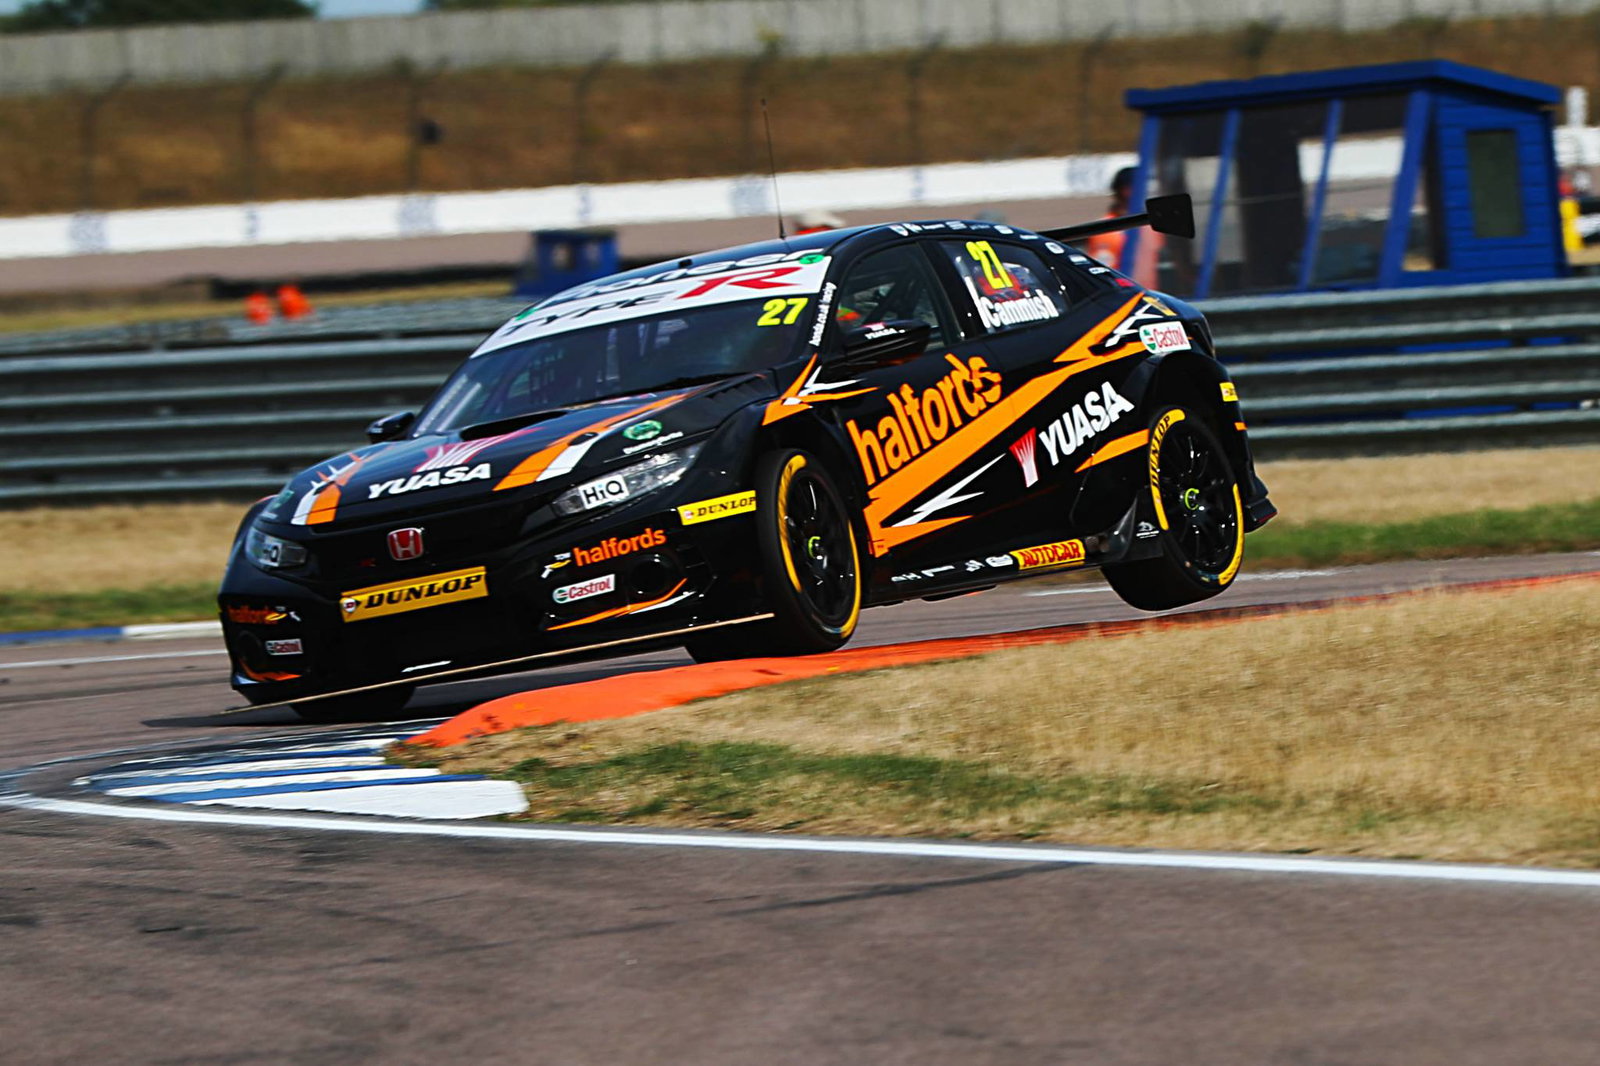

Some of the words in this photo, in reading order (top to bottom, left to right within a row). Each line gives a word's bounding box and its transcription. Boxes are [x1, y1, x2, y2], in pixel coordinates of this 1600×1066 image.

[966, 241, 1013, 289] 27
[675, 267, 803, 299] R
[757, 298, 808, 326] 27
[979, 289, 1060, 328] Cammish
[1153, 327, 1188, 349] Castrol
[846, 353, 1003, 486] halfords
[1038, 382, 1135, 466] YUASA
[368, 463, 491, 499] YUASA
[582, 480, 625, 505] HiQ
[697, 497, 756, 517] DUNLOP
[573, 528, 666, 566] halfords
[1022, 542, 1080, 568] AUTOCAR
[364, 574, 482, 609] DUNLOP
[568, 581, 611, 599] Castrol
